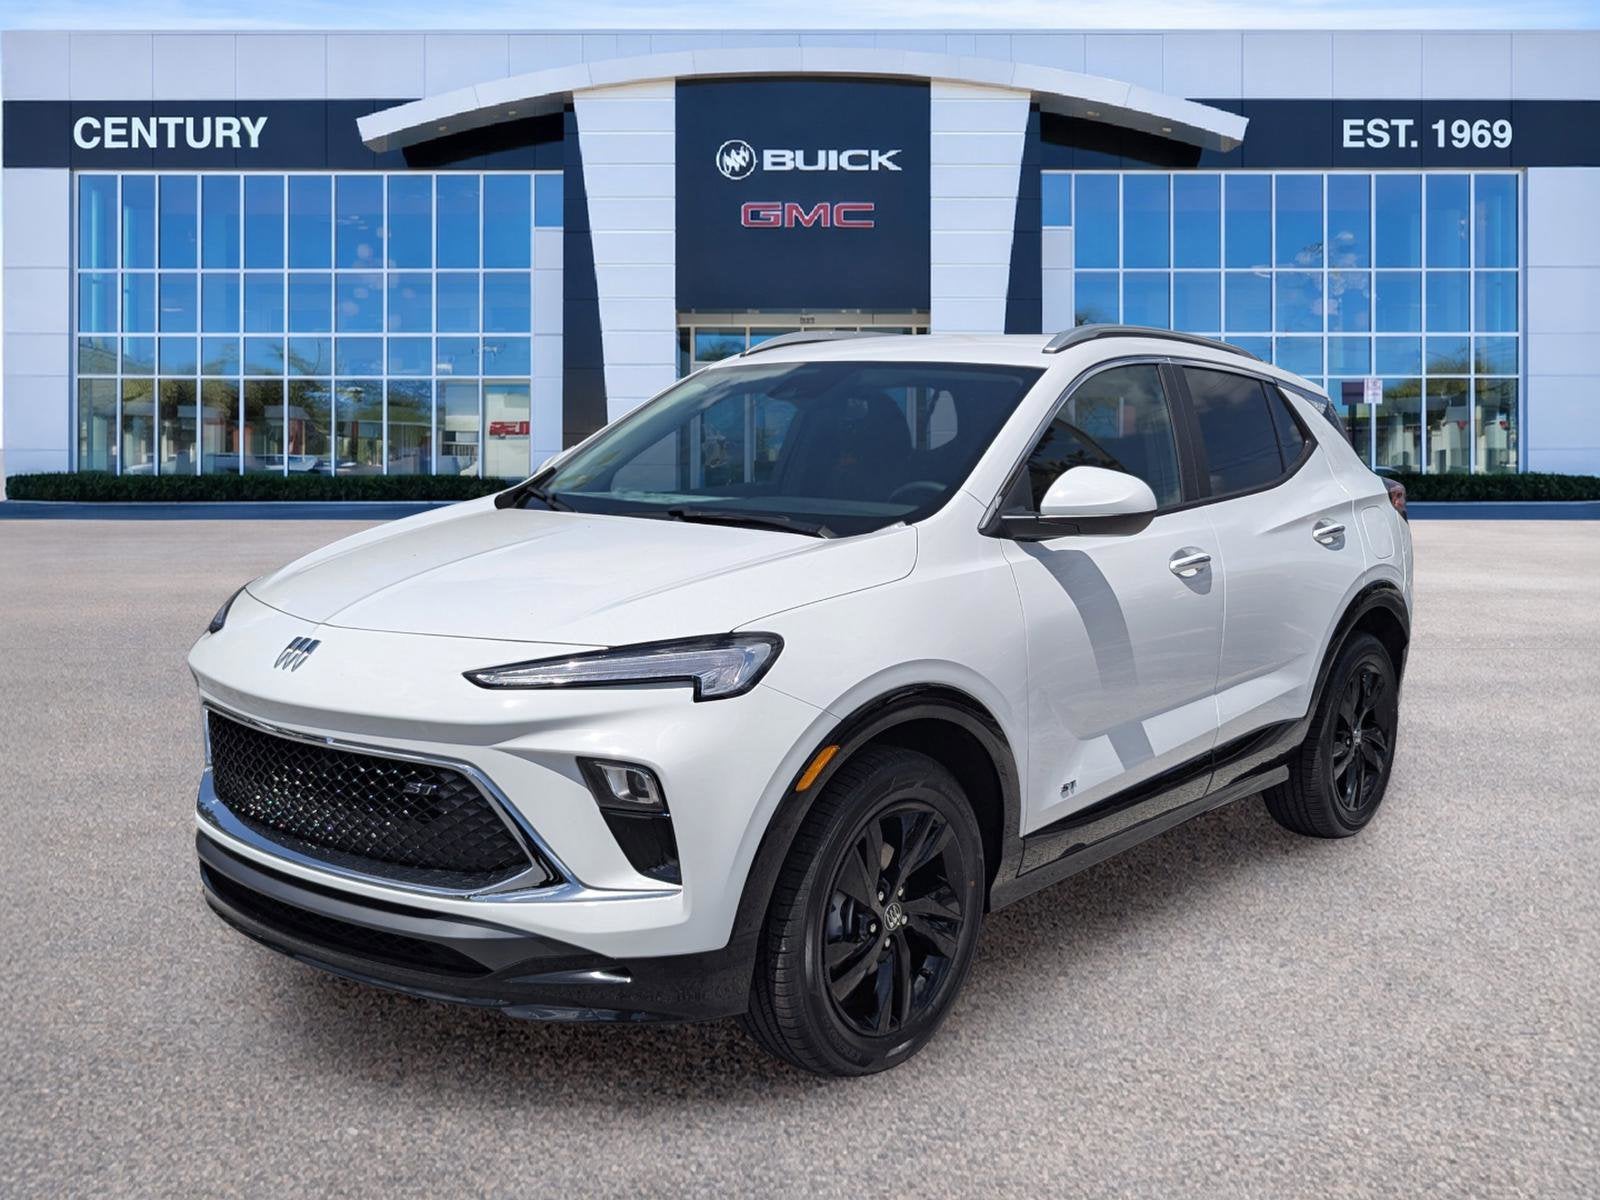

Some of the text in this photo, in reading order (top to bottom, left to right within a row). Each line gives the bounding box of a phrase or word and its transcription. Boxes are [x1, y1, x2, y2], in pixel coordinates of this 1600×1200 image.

[73, 116, 268, 149] CENTURY
[1343, 118, 1512, 148] EST. 1969
[763, 149, 902, 171] BUICK
[741, 202, 874, 227] GMC
[1061, 780, 1076, 792] ST
